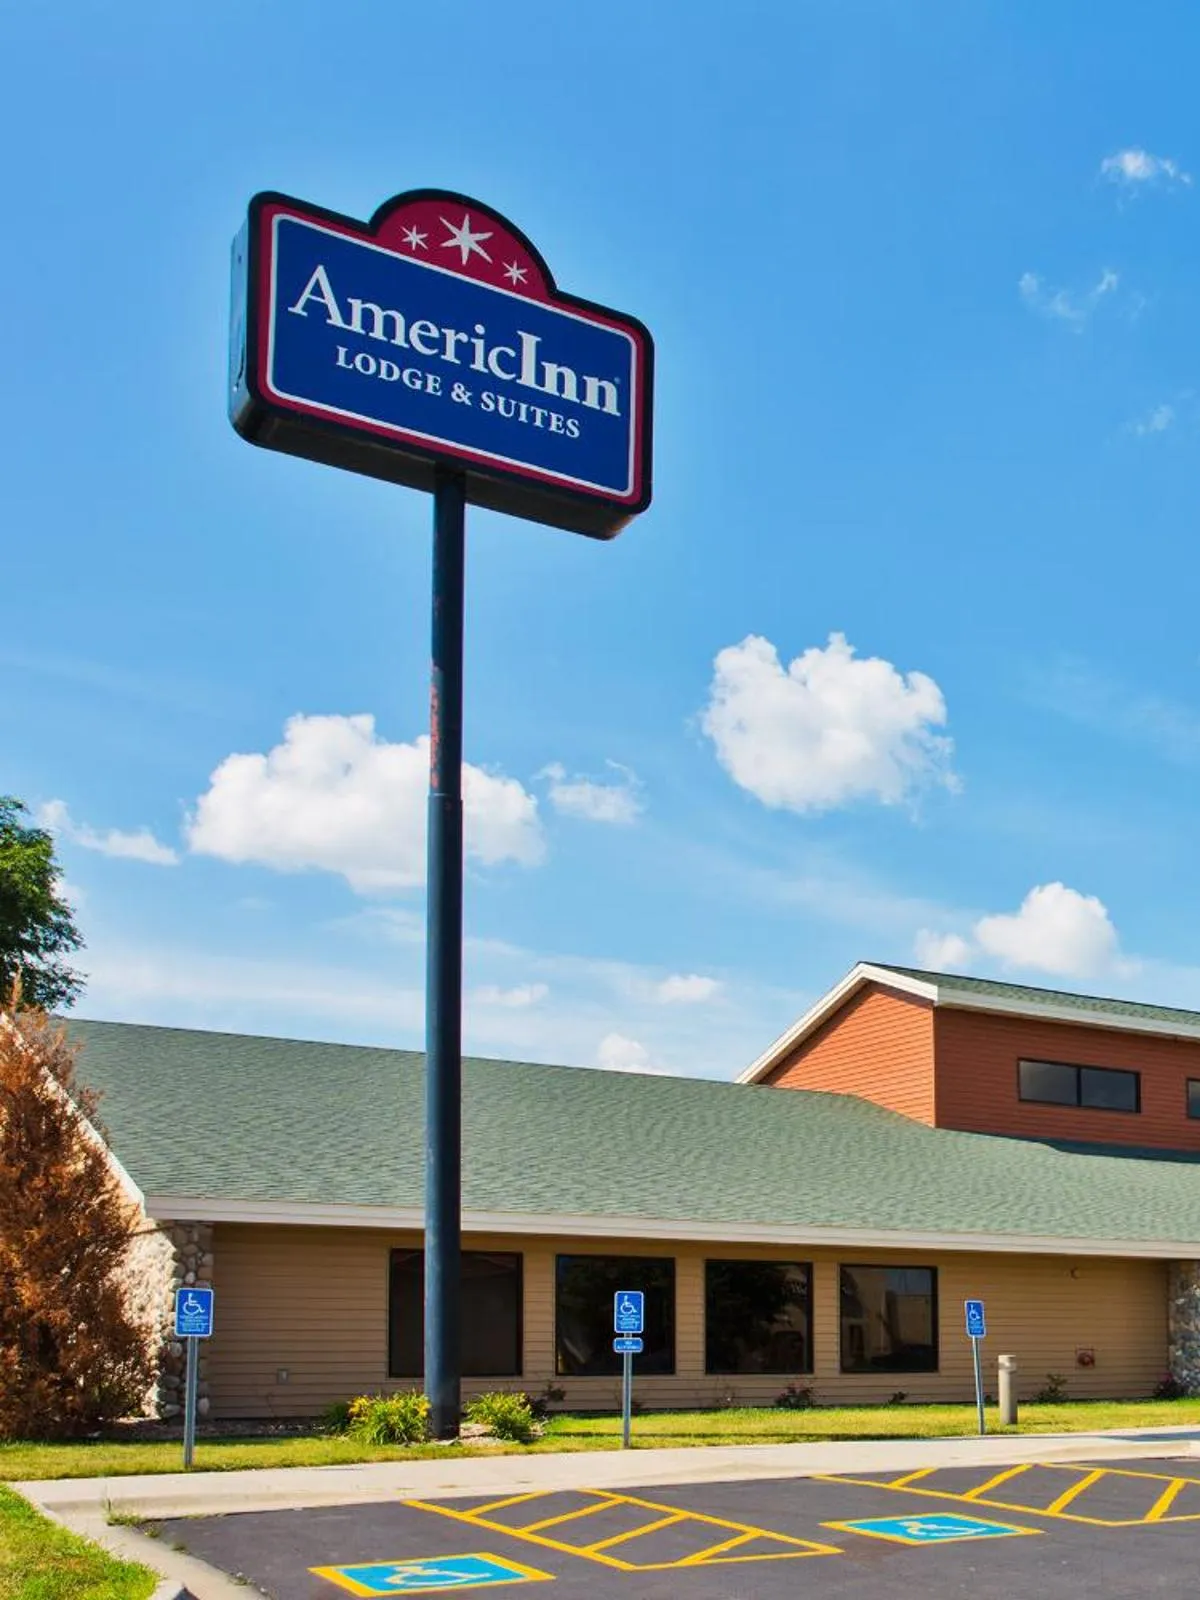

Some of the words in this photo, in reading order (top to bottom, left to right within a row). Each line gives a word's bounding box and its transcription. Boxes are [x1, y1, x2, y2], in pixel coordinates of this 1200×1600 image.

[287, 264, 621, 417] AmericInn
[336, 345, 442, 396] LODGE
[451, 382, 473, 406] &
[480, 391, 581, 438] SUITES
